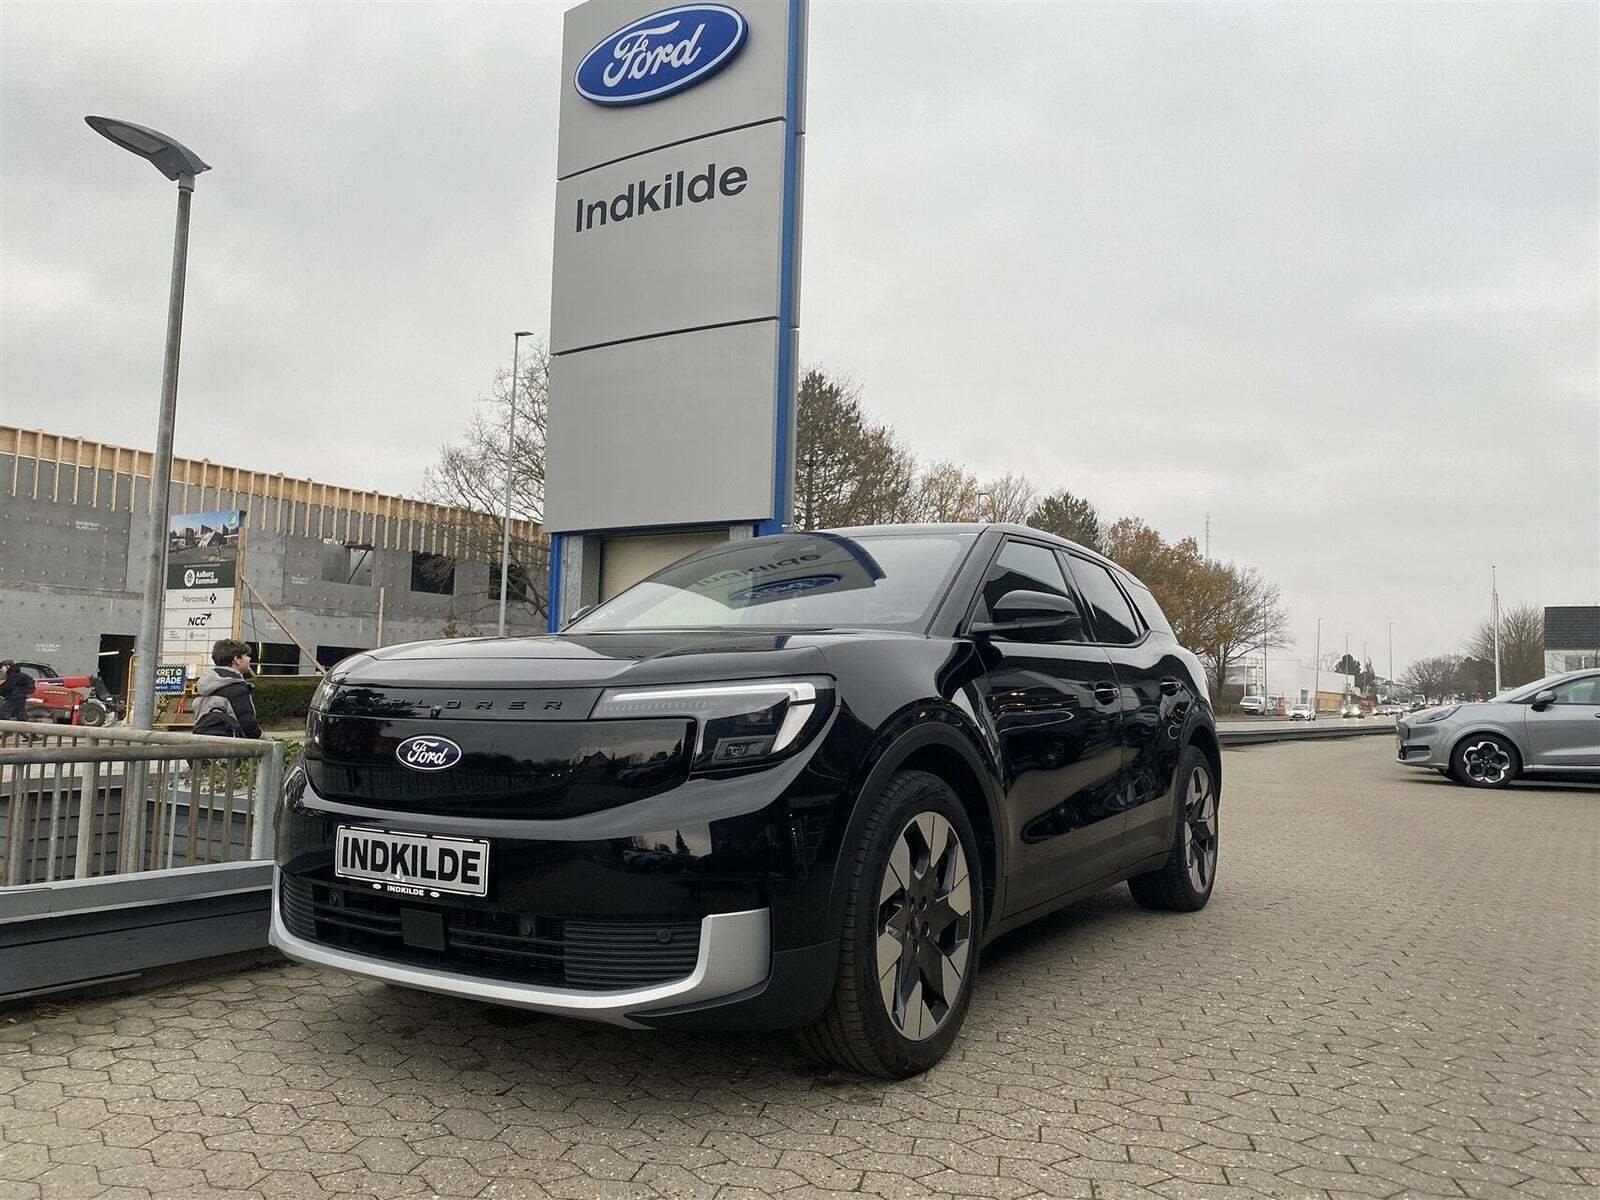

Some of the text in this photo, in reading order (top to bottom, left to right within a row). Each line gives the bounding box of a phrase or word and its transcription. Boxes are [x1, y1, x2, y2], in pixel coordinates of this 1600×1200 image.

[602, 20, 706, 88] Ford
[576, 163, 748, 233] Indkilde
[182, 593, 210, 603] Norconsult
[187, 616, 207, 626] NCC
[407, 740, 449, 765] Ford
[341, 836, 481, 886] INDKILDE
[386, 884, 426, 897] INDKILDE
